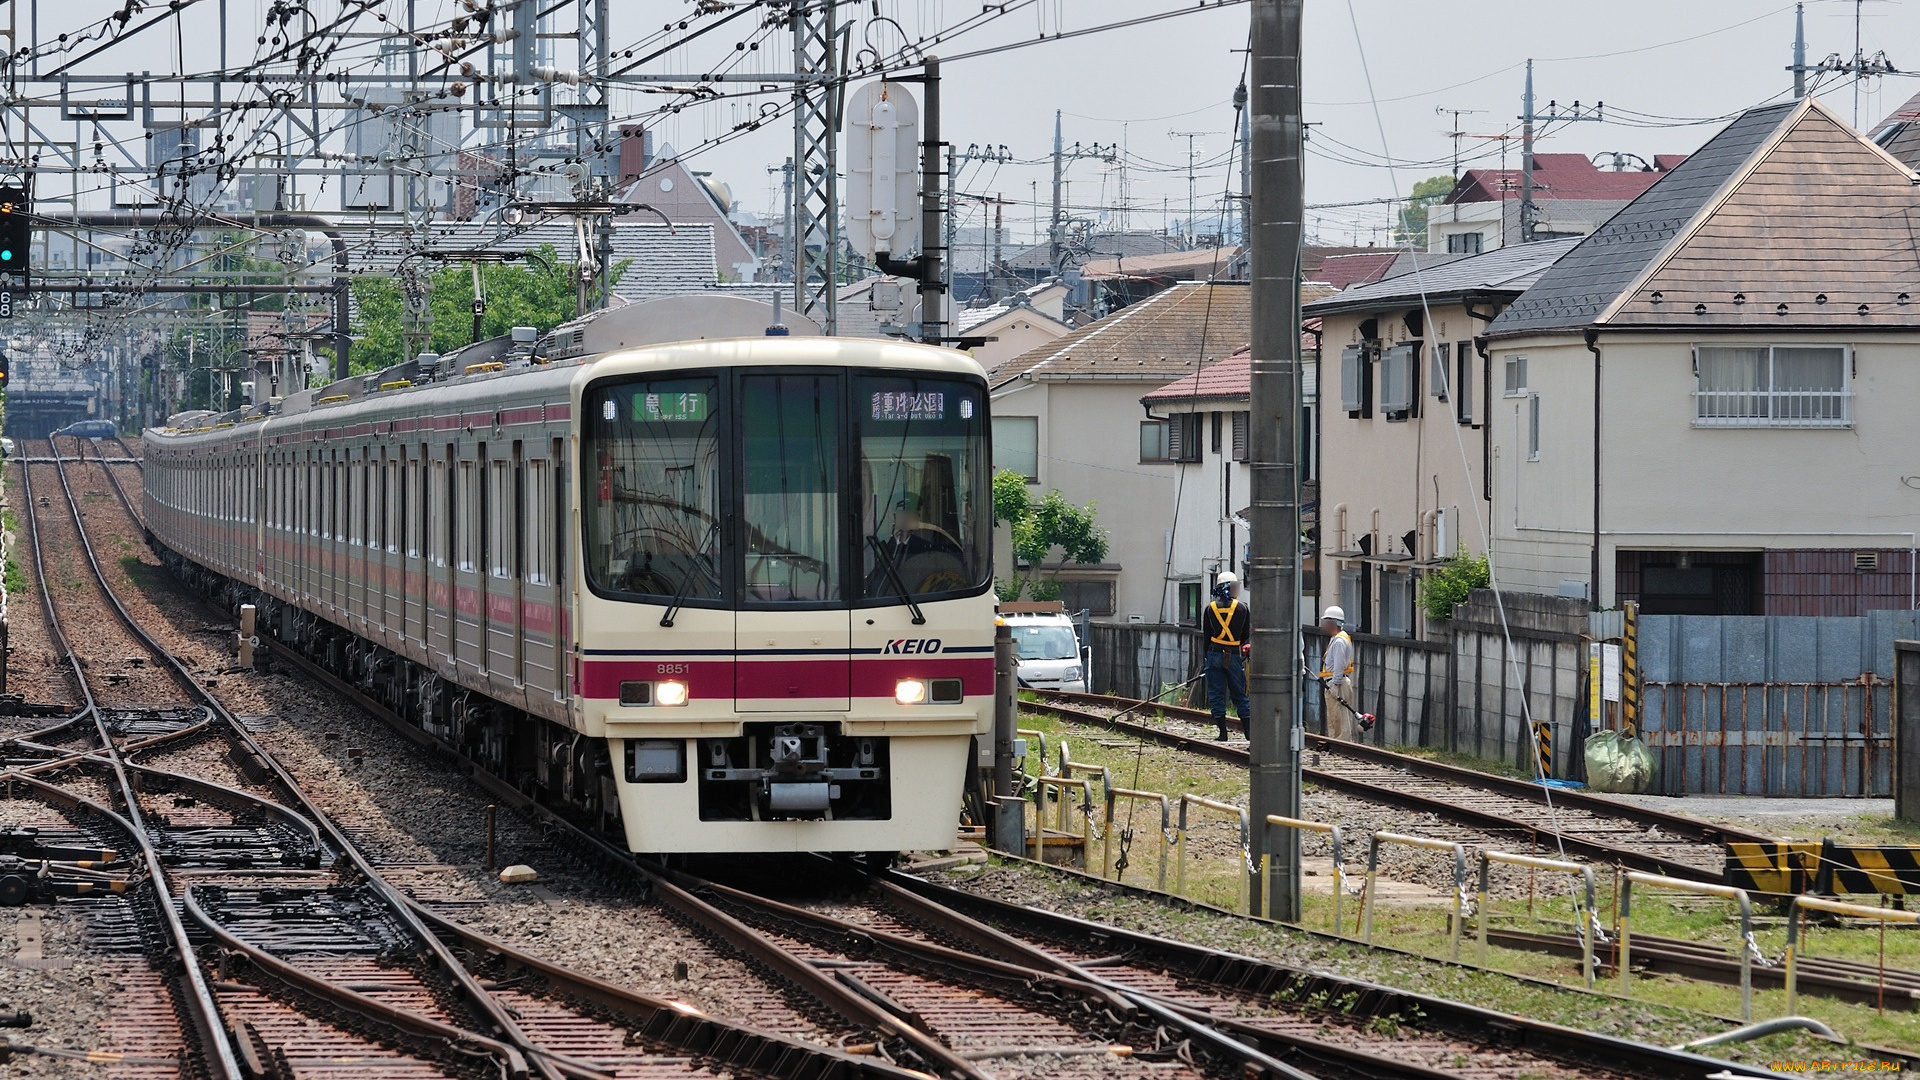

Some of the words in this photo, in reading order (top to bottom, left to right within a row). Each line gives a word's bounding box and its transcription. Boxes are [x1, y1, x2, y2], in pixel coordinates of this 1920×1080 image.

[646, 392, 698, 413] 急行
[884, 639, 941, 654] KEIO
[656, 663, 690, 675] 8851
